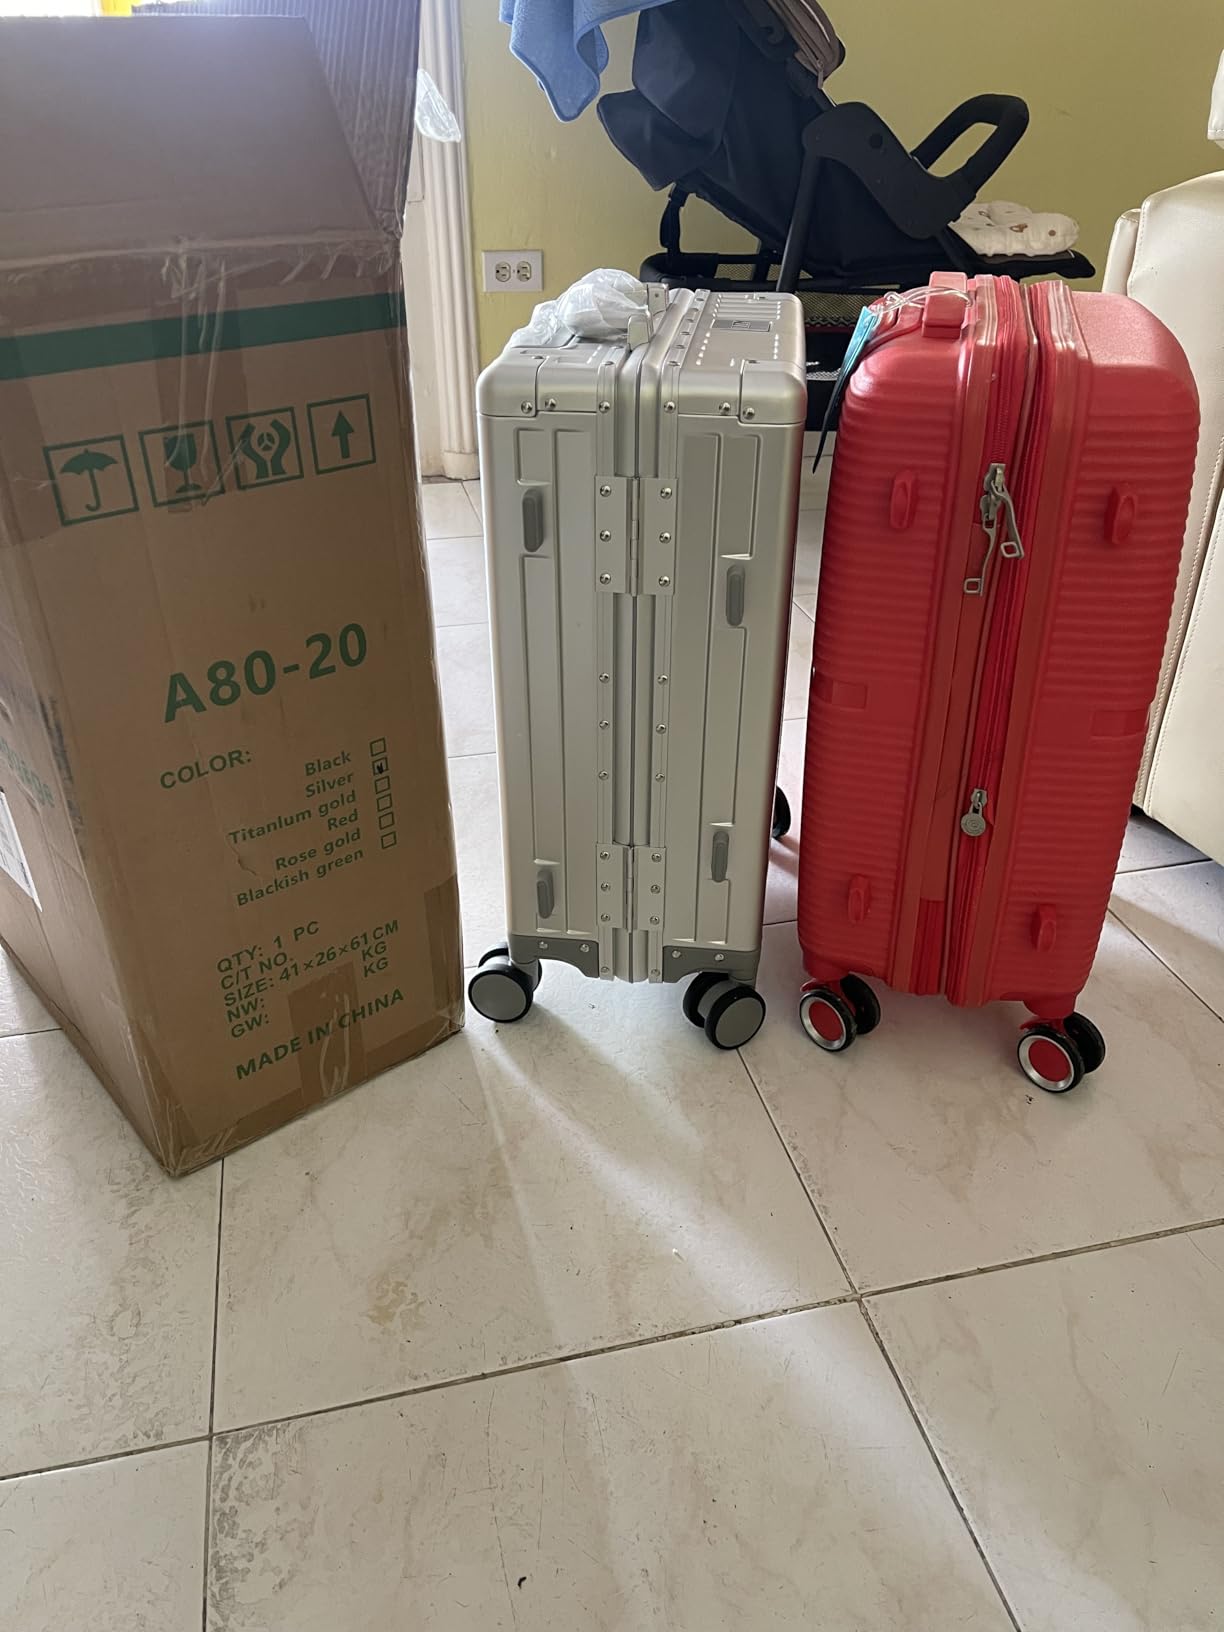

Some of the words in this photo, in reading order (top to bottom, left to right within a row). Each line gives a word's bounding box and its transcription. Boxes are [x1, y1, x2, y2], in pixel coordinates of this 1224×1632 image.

[165, 623, 367, 723] A80-20
[160, 749, 252, 789] COLOR:
[305, 750, 352, 776] Black
[305, 771, 354, 798] Silver
[318, 790, 357, 818] gold
[327, 809, 359, 831] Red
[275, 847, 318, 871] Rose
[324, 828, 361, 855] gold
[236, 869, 309, 906] Blackish
[316, 849, 364, 878] green
[217, 945, 263, 973] QTY:
[273, 935, 282, 949] 1
[293, 921, 319, 942] PC
[221, 966, 252, 990] C/T
[258, 952, 294, 973] NO.
[226, 997, 265, 1023] NW:
[361, 941, 387, 961] KG
[224, 977, 275, 1007] SIZE:
[231, 1013, 270, 1038] GW:
[363, 957, 389, 977] KG
[235, 1036, 303, 1080] MADE
[308, 1022, 332, 1045] IN
[337, 988, 404, 1030] CHINA
